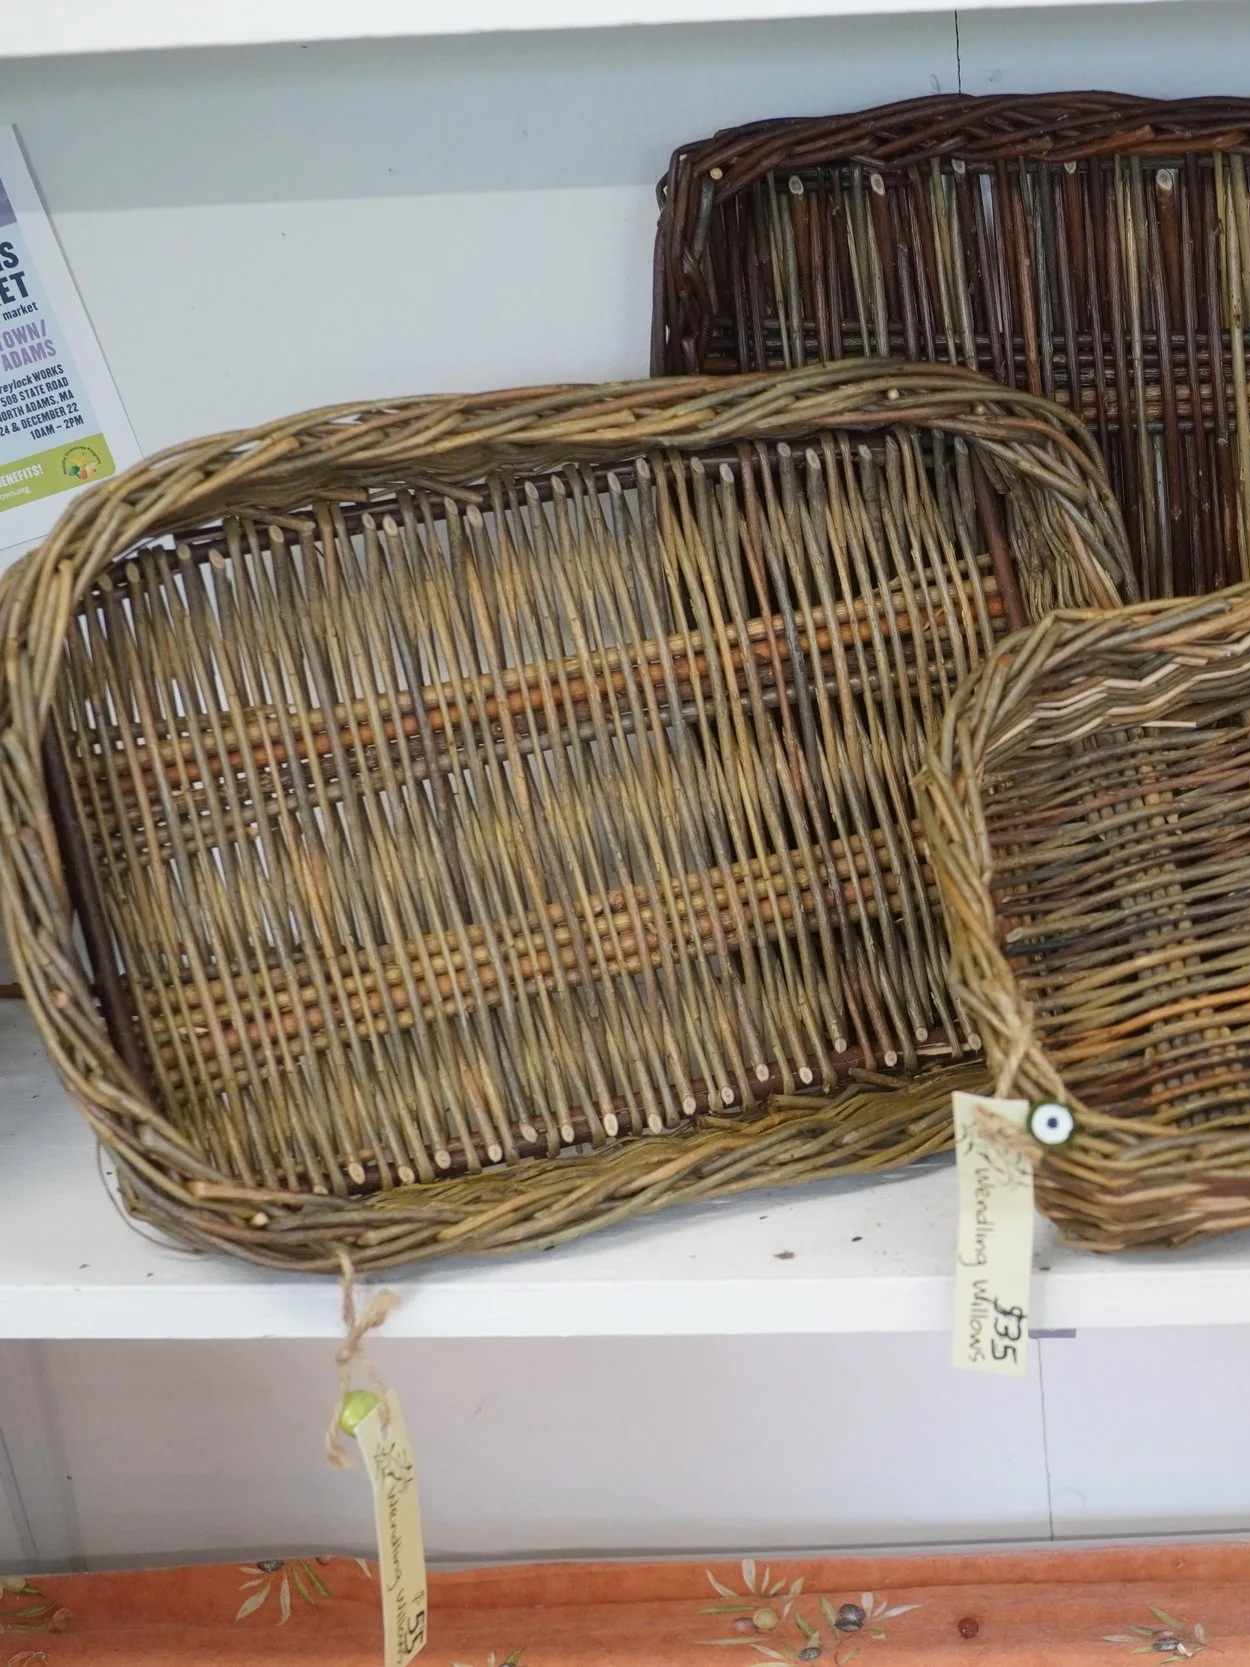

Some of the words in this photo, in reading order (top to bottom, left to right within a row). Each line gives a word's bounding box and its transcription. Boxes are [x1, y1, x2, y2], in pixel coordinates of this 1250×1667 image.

[0, 242, 19, 271] S
[0, 271, 29, 305] ET
[3, 302, 39, 321] market
[1, 339, 57, 372] ADAMS
[32, 364, 64, 382] WORKS
[1, 393, 19, 407] 508
[19, 384, 46, 401] STATE
[45, 376, 69, 393] ROAD
[25, 395, 60, 414] ADAMS,
[59, 389, 75, 403] MA
[11, 422, 21, 433] &
[20, 406, 67, 429] DECEMBER
[66, 402, 79, 415] 22
[30, 424, 56, 440] 10AM
[63, 414, 84, 429] 2PM
[959, 1167, 996, 1267] Wendling
[969, 1279, 989, 1363] Willows
[991, 1296, 1028, 1365] $35
[386, 1484, 402, 1592] Wendling
